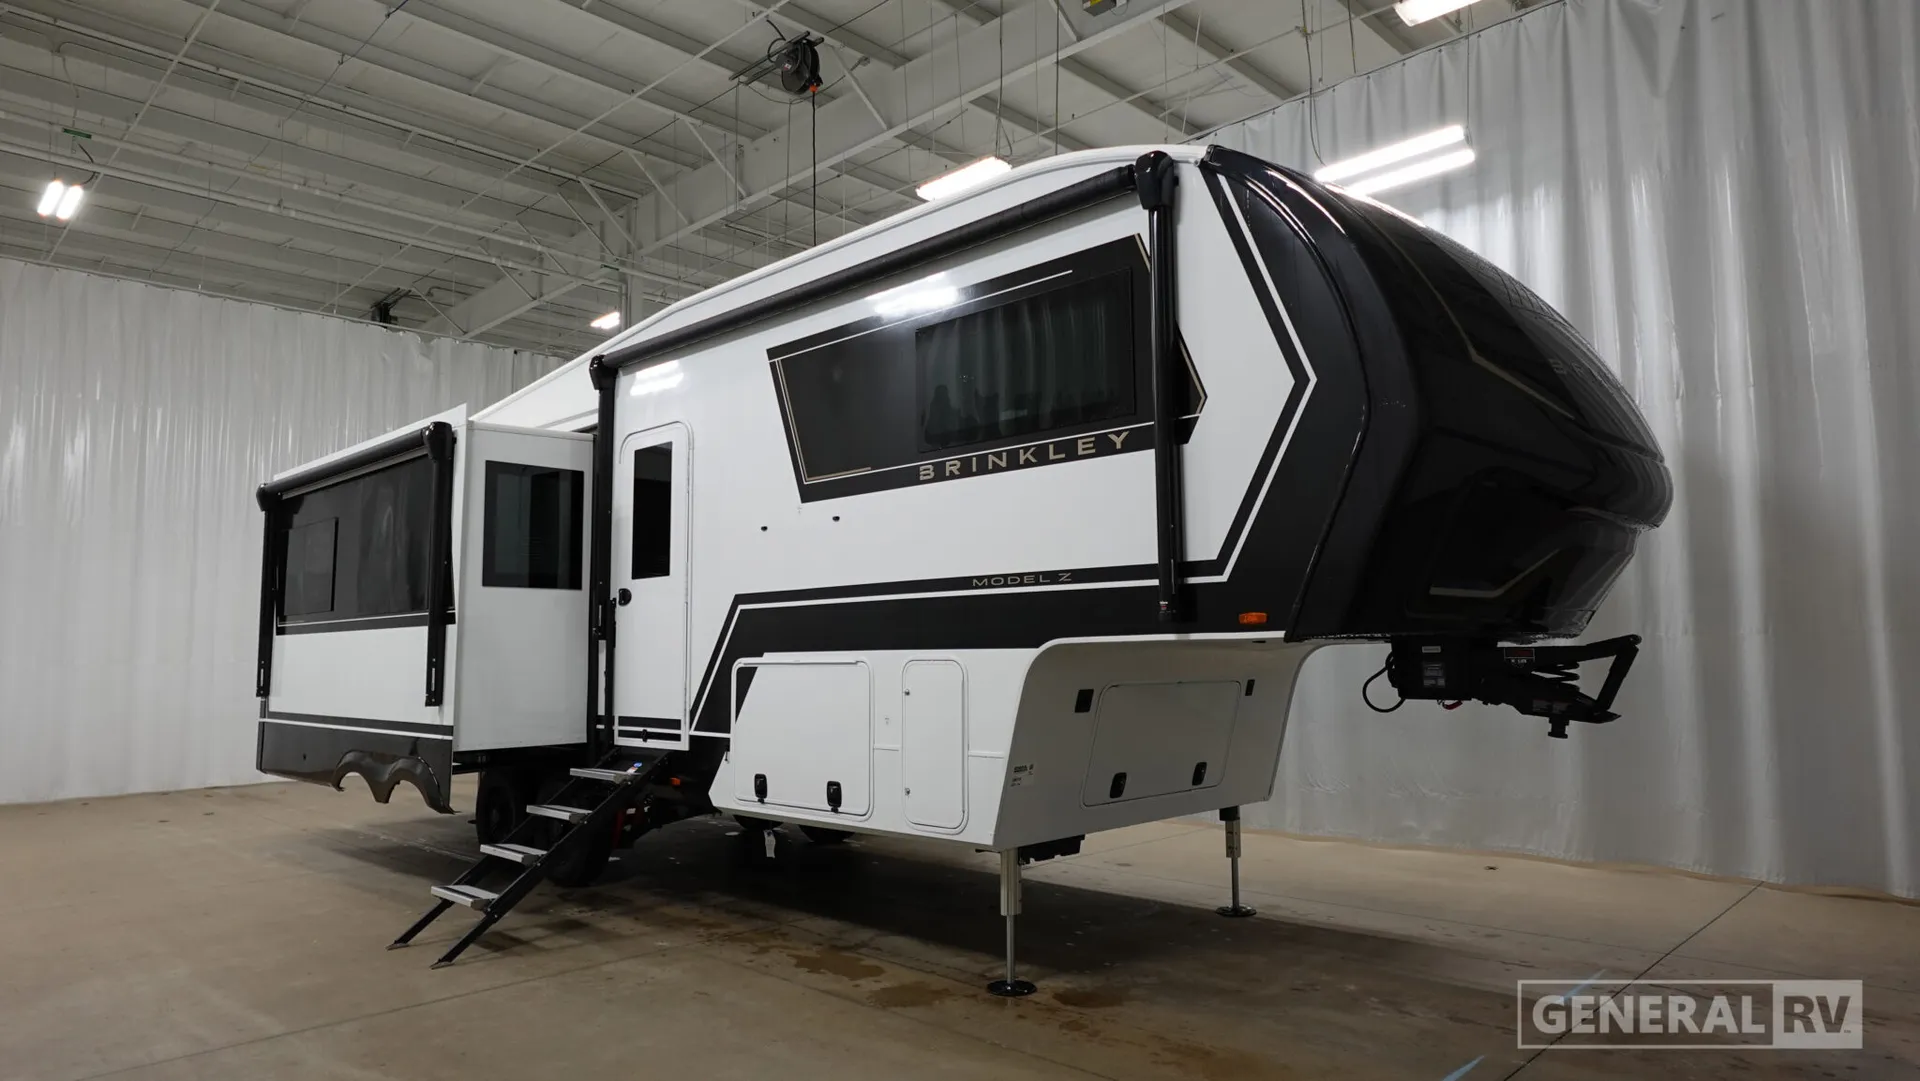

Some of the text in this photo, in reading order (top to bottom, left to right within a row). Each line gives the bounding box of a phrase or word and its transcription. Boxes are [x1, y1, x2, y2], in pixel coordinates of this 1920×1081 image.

[919, 431, 1129, 480] BRINKLEY
[972, 572, 1073, 587] MODEL Z
